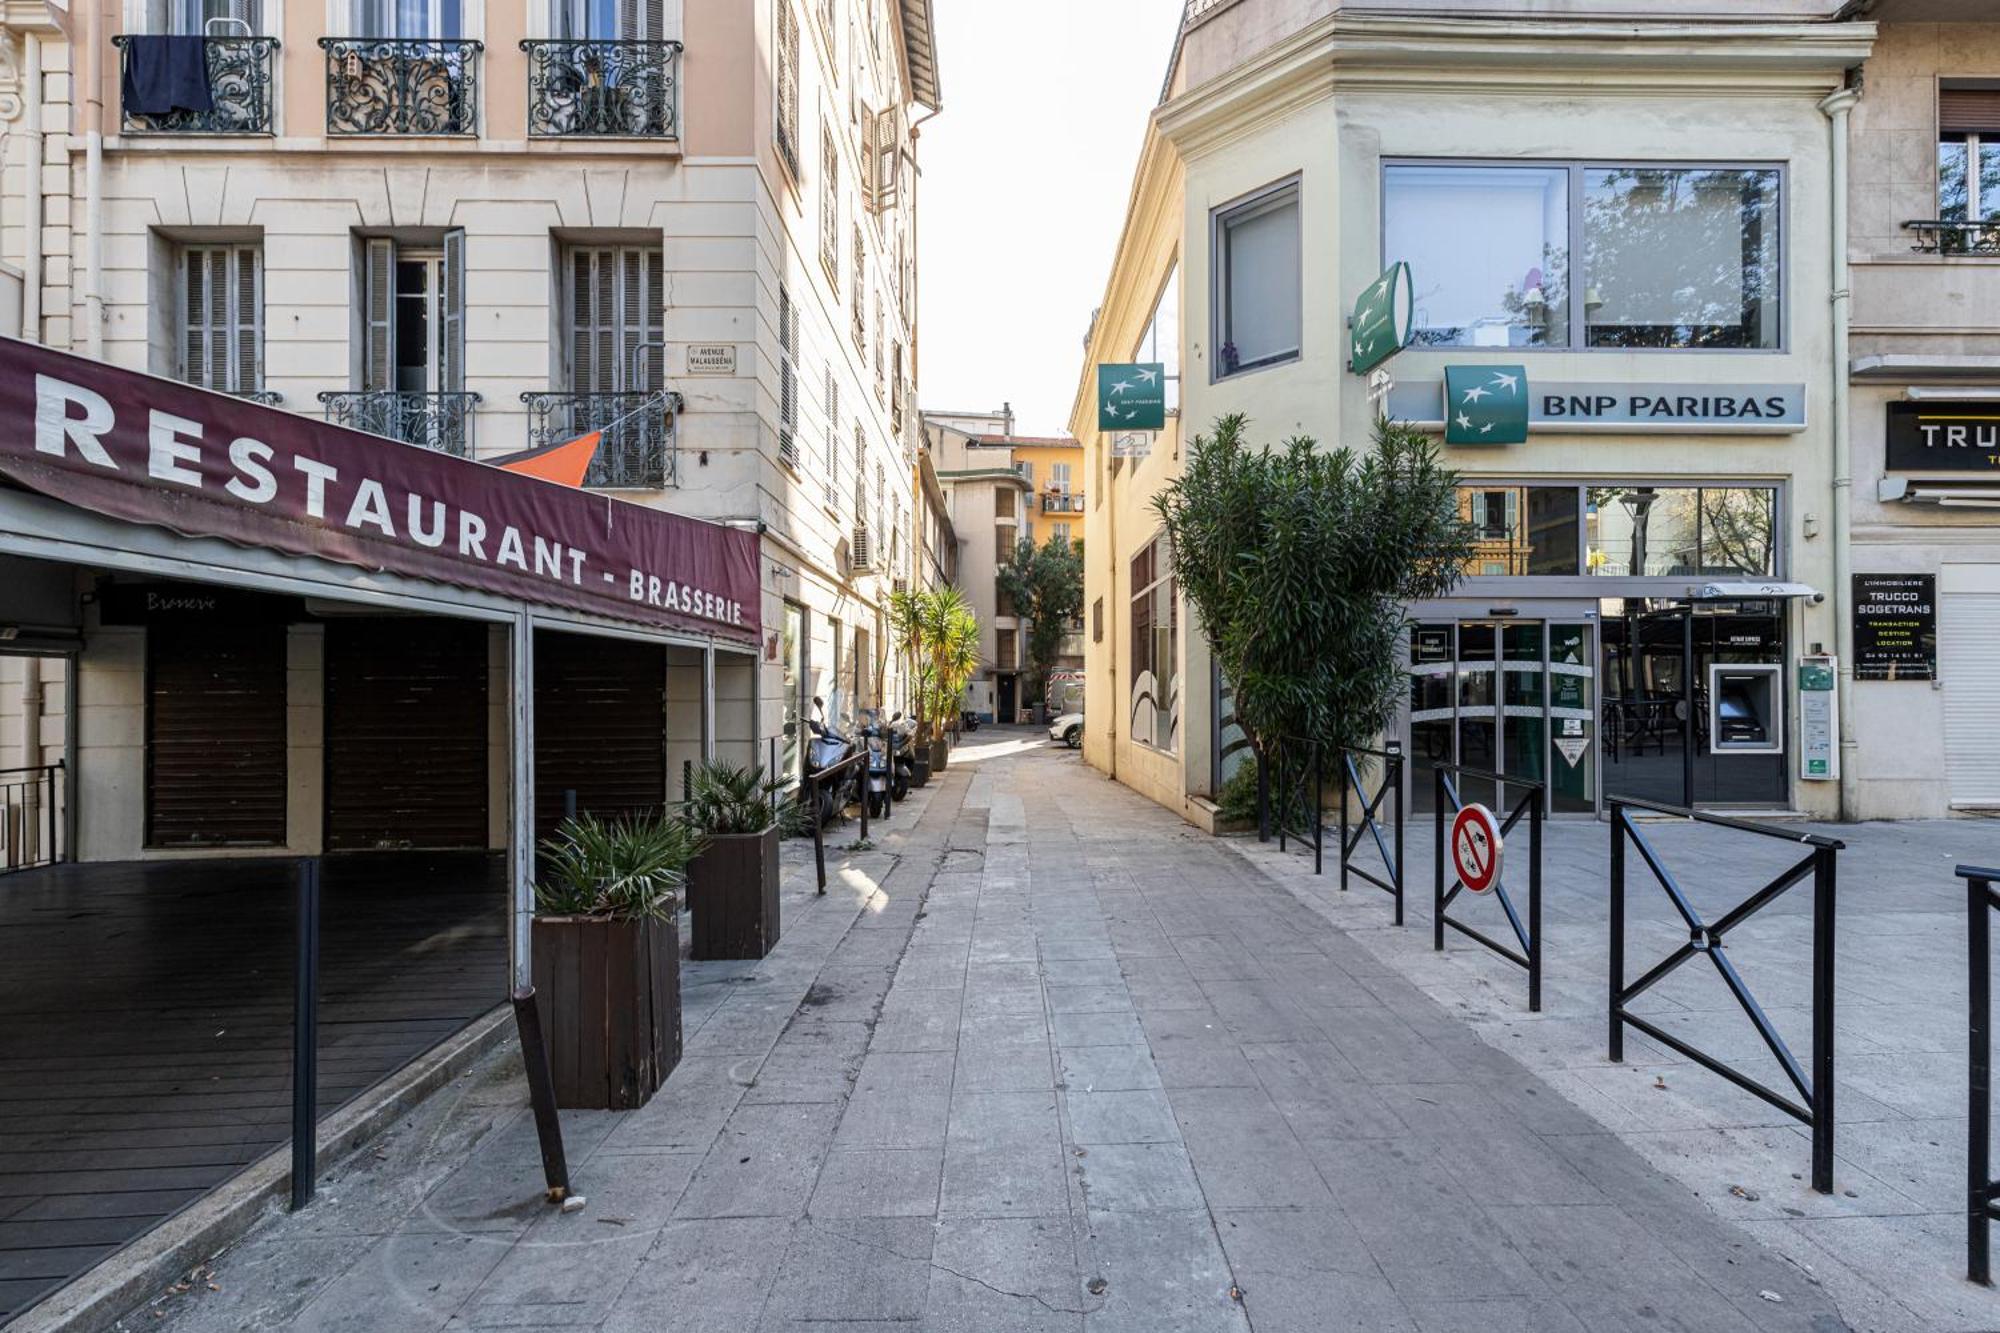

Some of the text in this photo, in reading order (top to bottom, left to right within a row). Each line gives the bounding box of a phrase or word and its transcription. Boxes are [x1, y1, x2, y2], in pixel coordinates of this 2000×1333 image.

[700, 348, 725, 356] AVENUE
[1543, 395, 1786, 418] BNP PARIBAS
[1920, 425, 1997, 447] TRU
[33, 372, 587, 585] RESTAURANT
[629, 568, 742, 625] BRASSERIE
[1869, 592, 1918, 601] TRUCCO
[1858, 605, 1930, 614] SOGETRANS
